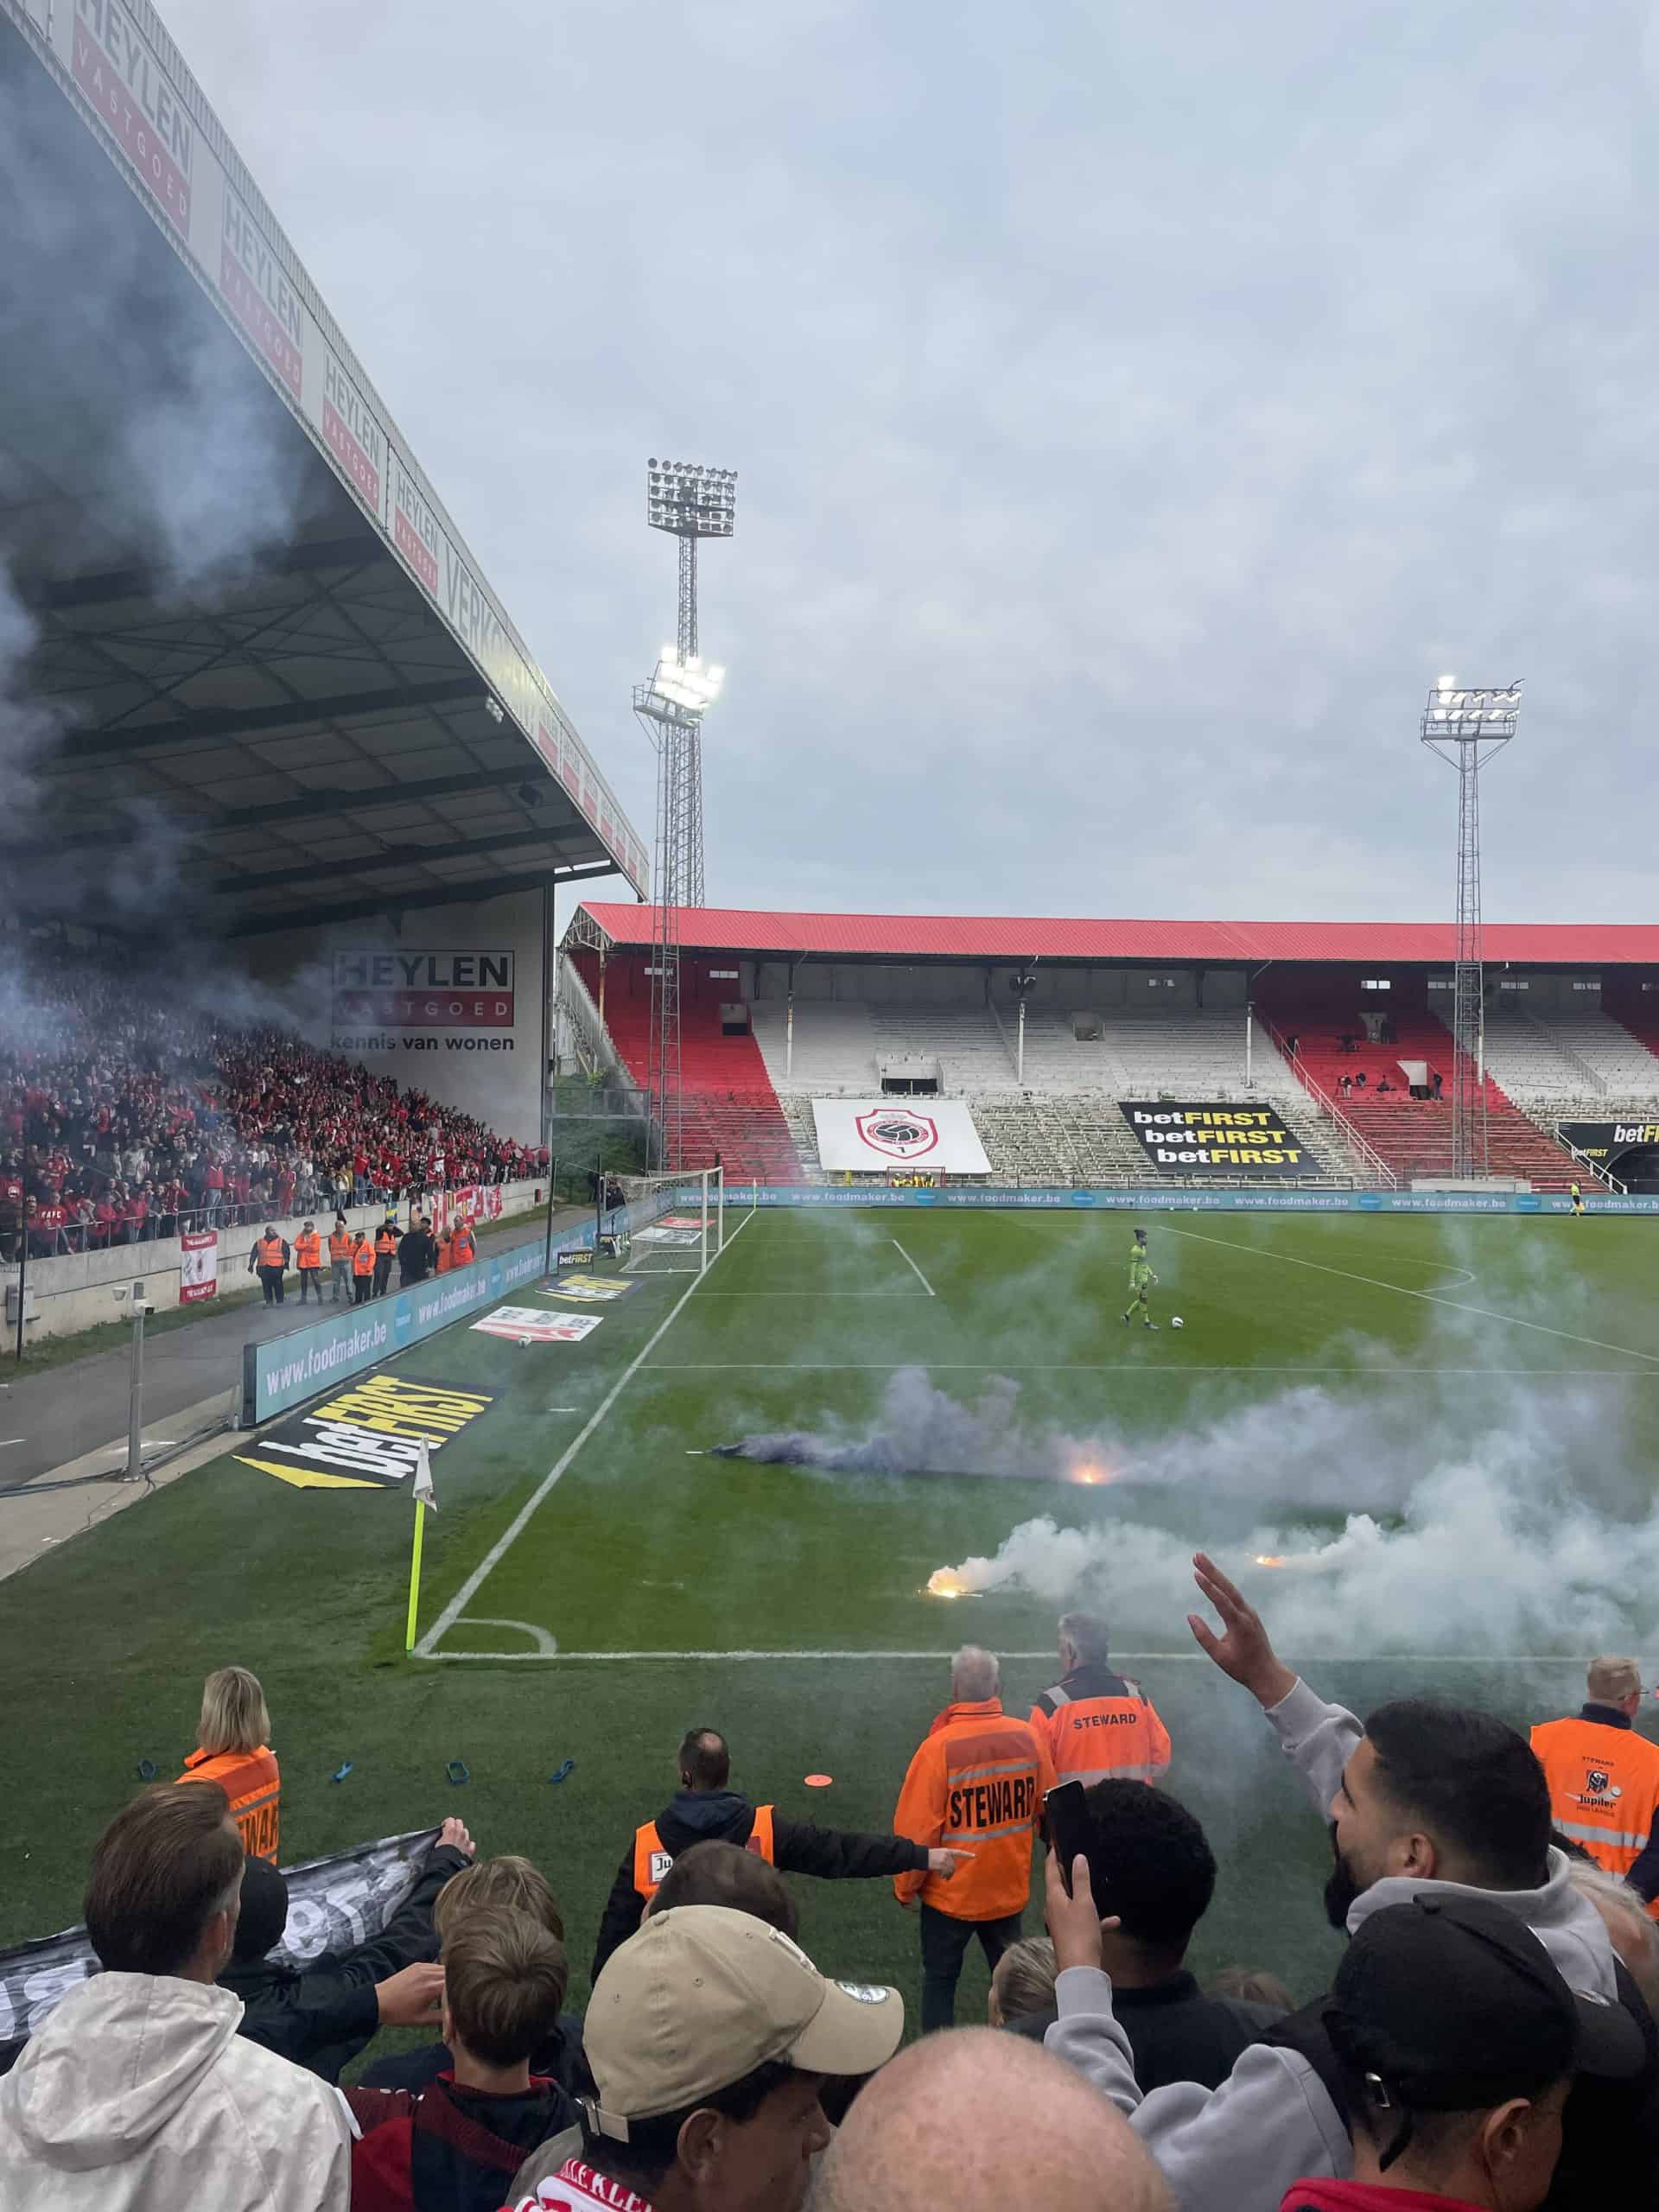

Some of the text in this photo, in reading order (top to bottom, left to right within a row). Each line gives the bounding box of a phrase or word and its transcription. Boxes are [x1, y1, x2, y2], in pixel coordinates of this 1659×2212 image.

[79, 38, 187, 216] VASTGOED
[226, 187, 301, 348] HEYLEN
[326, 357, 379, 467] HEYLEN
[325, 406, 378, 499] VASTGOED
[397, 471, 438, 555] HEYLEN
[338, 957, 508, 987] HEYLEN
[332, 1032, 515, 1051] kennis van wonen
[1134, 1111, 1271, 1126] betFIRST
[1145, 1129, 1287, 1144] betFIRST
[1157, 1148, 1302, 1164] betFIRST
[791, 1192, 906, 1203] www.foodmaker.be
[947, 1192, 1062, 1203] www.foodmaker.be
[1106, 1195, 1220, 1205] www.foodmaker.be
[1235, 1197, 1349, 1206] www.foodmaker.be
[1391, 1198, 1507, 1208] www.foodmaker.be
[266, 1320, 387, 1396] www.foodmaker.be
[258, 1376, 493, 1478] betFIRST
[1073, 1713, 1137, 1729] STEWARD
